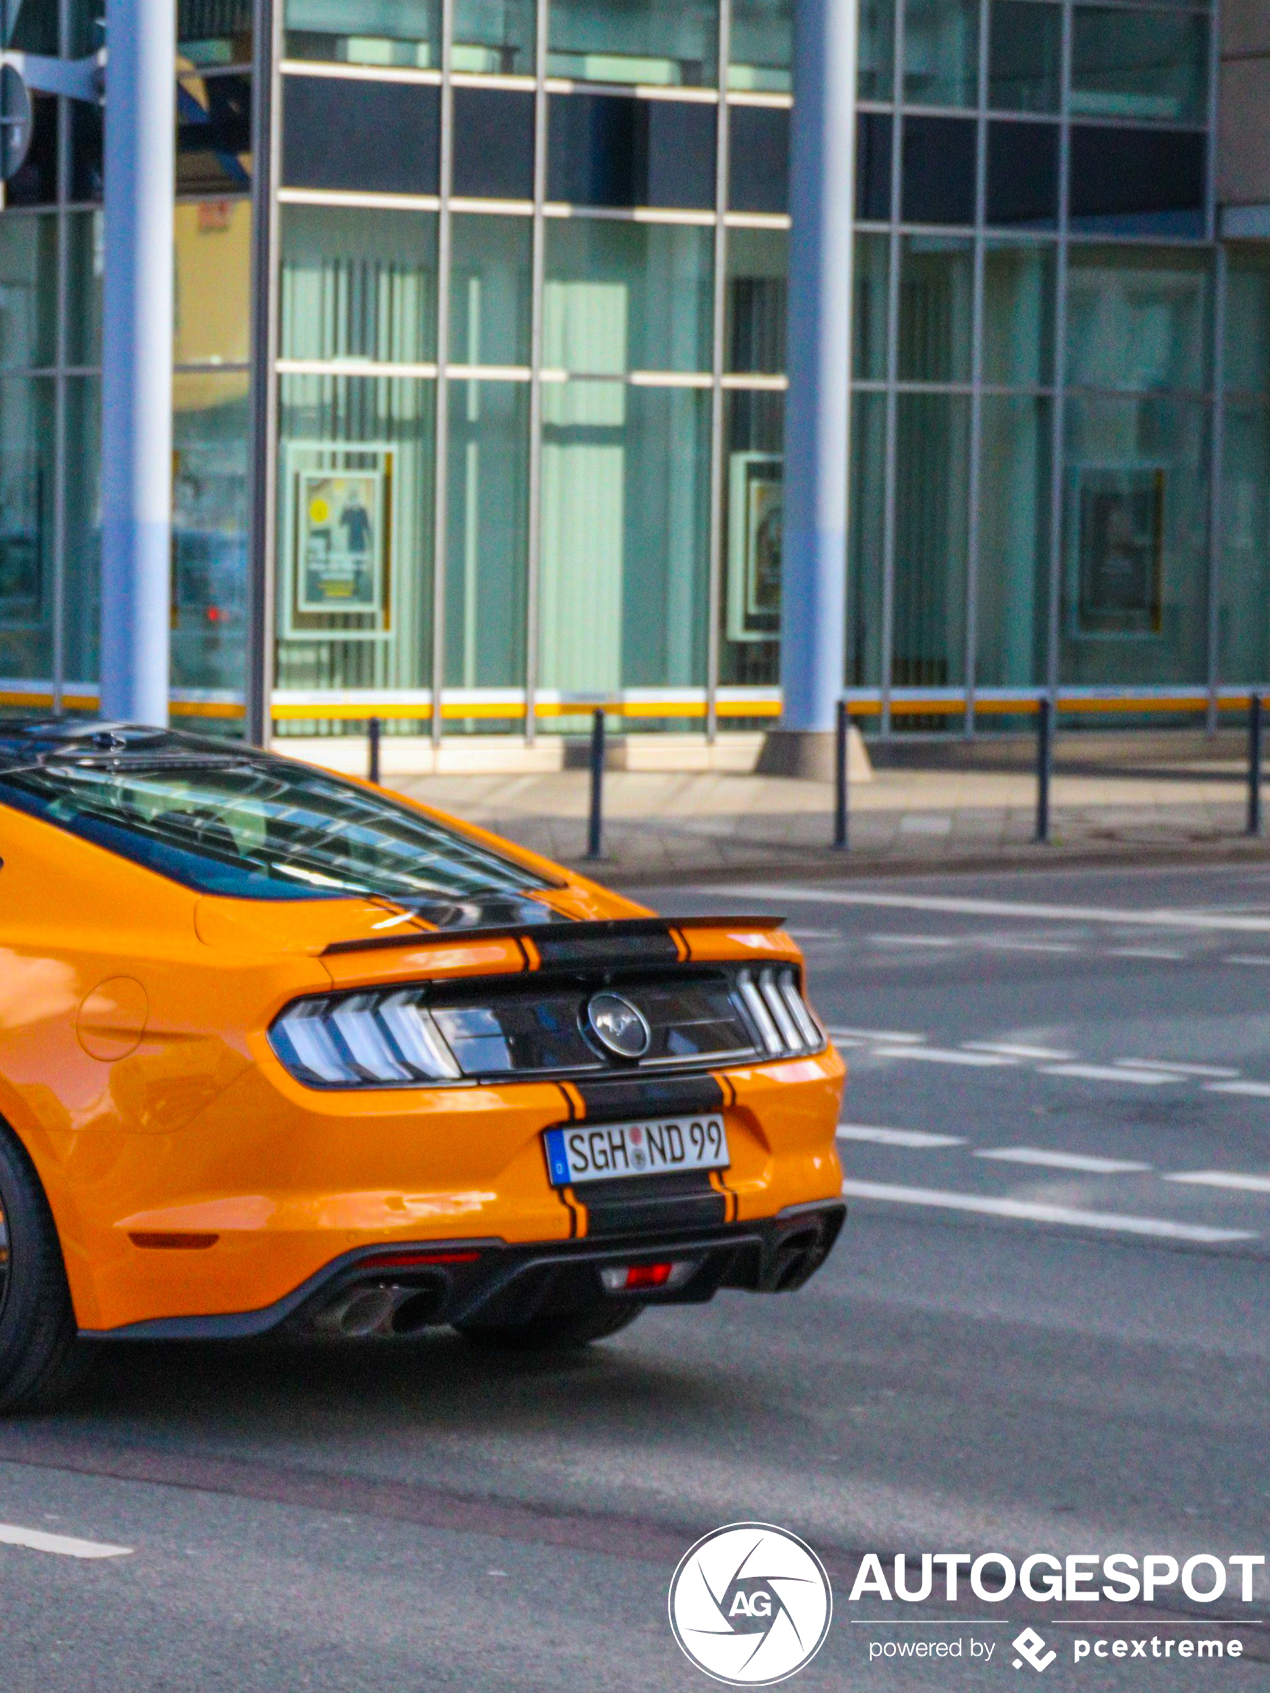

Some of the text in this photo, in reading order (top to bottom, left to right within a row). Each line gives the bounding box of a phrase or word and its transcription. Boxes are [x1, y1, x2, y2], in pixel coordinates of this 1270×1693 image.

[569, 1121, 722, 1173] SGH ND 99
